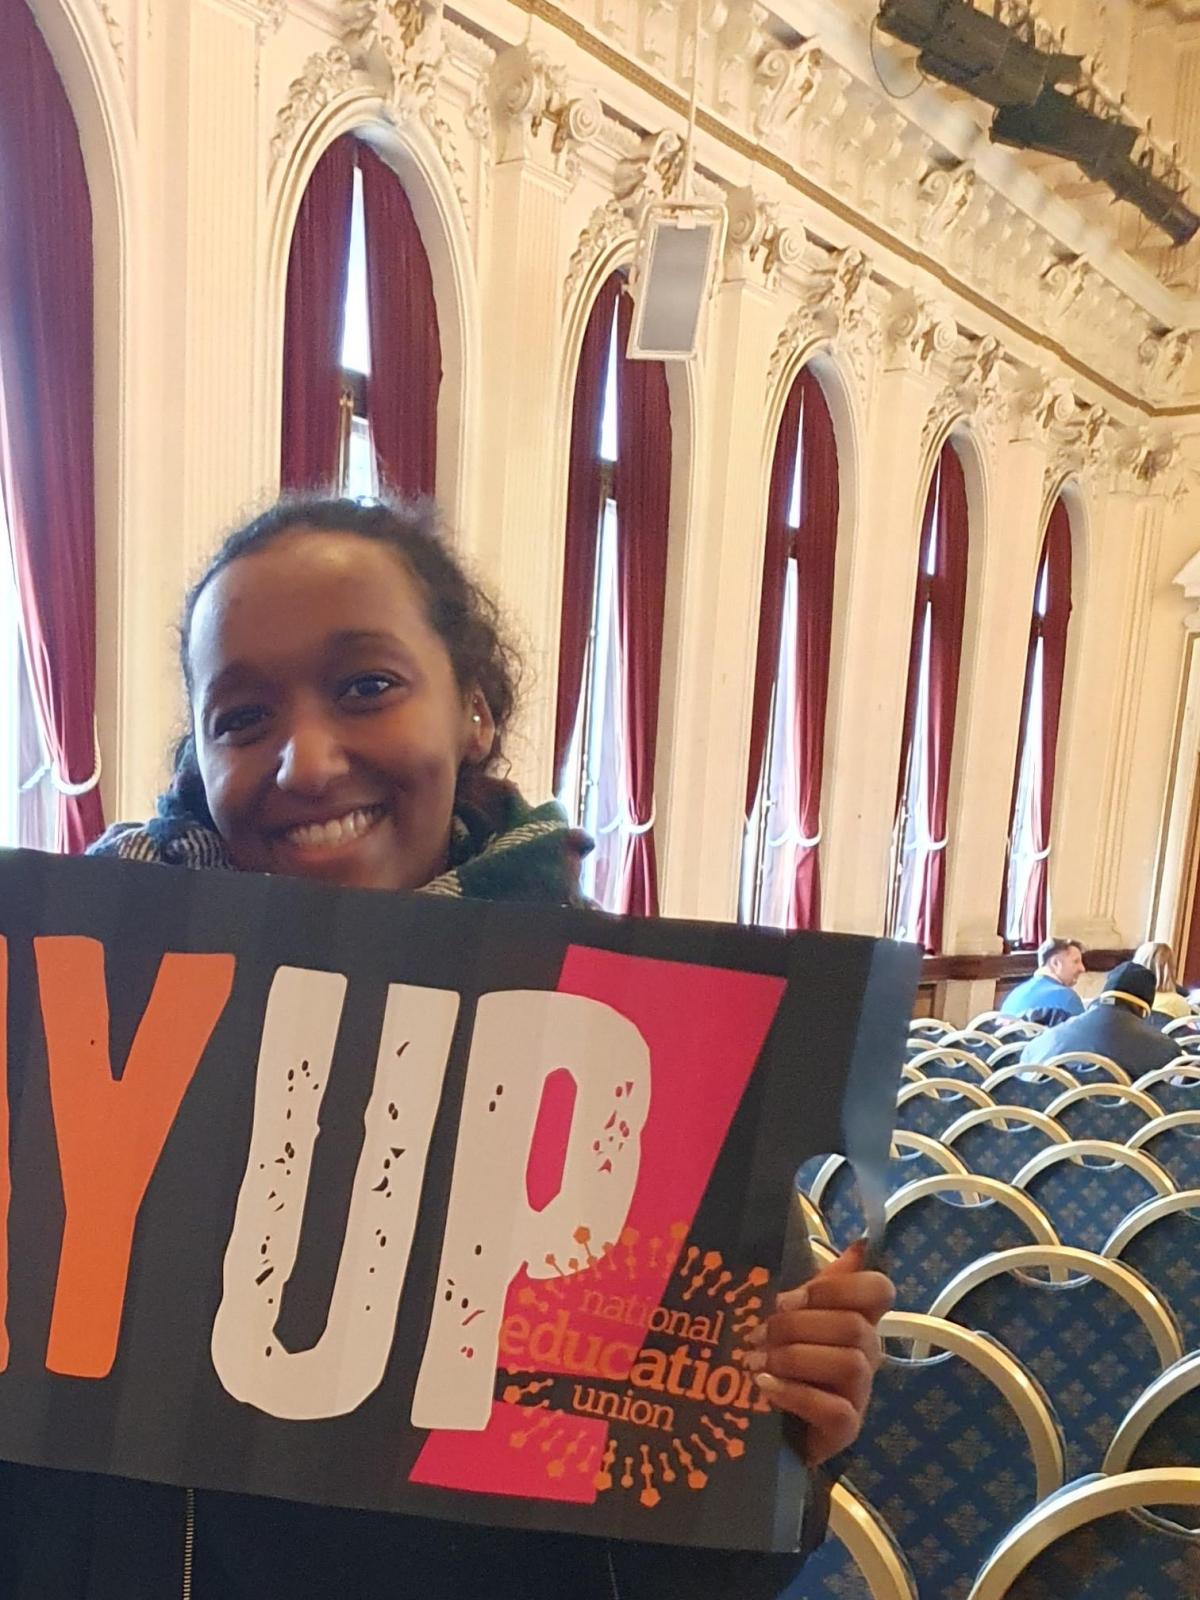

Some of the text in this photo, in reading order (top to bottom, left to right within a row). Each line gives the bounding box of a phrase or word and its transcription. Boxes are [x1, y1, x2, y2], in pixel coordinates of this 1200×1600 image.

[211, 966, 652, 1432] UP
[578, 1286, 725, 1345] national
[571, 1383, 676, 1432] union
